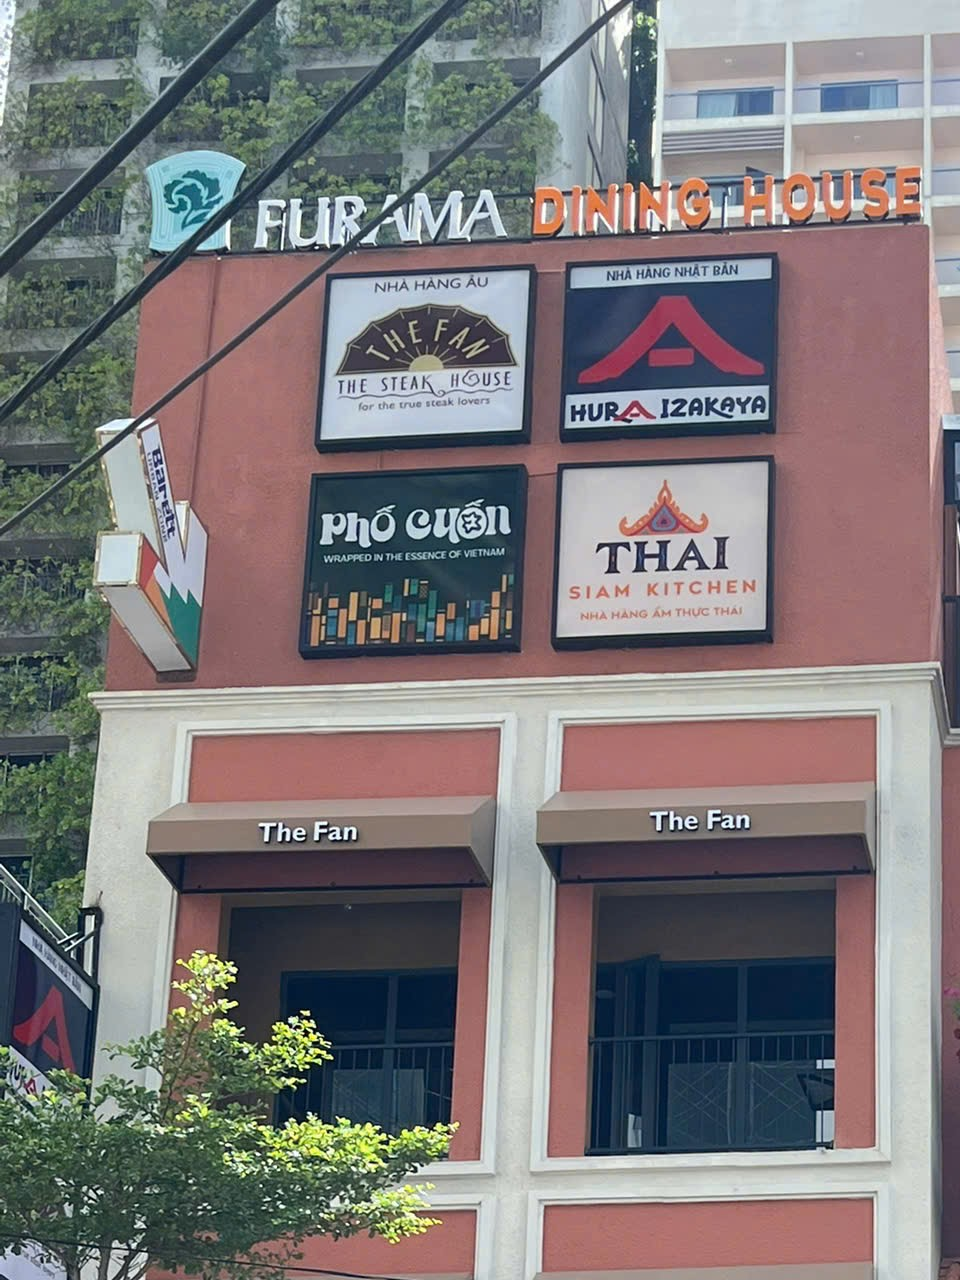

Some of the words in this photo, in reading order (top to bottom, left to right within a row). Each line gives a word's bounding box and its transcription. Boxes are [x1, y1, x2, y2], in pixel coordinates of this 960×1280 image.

[254, 188, 509, 250] FURAMA
[533, 177, 711, 237] DINING
[743, 167, 922, 226] HOUSE
[606, 269, 632, 281] NHÀ
[636, 266, 671, 279] HÀNG
[674, 264, 709, 279] NHẬT
[712, 261, 738, 276] BẢN
[374, 278, 409, 293] NHÀ
[414, 276, 461, 291] HÀNG
[366, 320, 422, 361] THE
[434, 319, 490, 359] FAN
[338, 378, 367, 394] THE
[381, 374, 445, 397] STEAK
[450, 369, 512, 388] HOUSE
[358, 402, 374, 412] for
[378, 401, 395, 410] the
[399, 400, 422, 409] true
[426, 398, 454, 407] steak
[457, 397, 490, 406] lovers
[570, 400, 657, 423] HURA
[660, 395, 767, 418] IZAKAYA
[323, 553, 372, 563] WRAPPED
[374, 553, 384, 562] IN
[385, 552, 403, 561] THE
[405, 551, 446, 560] ESSENCE
[448, 550, 462, 558] OF
[464, 548, 505, 558] VIETNAM
[595, 536, 730, 574] THAI
[569, 583, 631, 600] SIAM
[646, 579, 757, 597] KITCHEN
[259, 821, 307, 843] The
[312, 820, 359, 842] Fan
[650, 810, 698, 832] The
[706, 808, 751, 830] Fan
